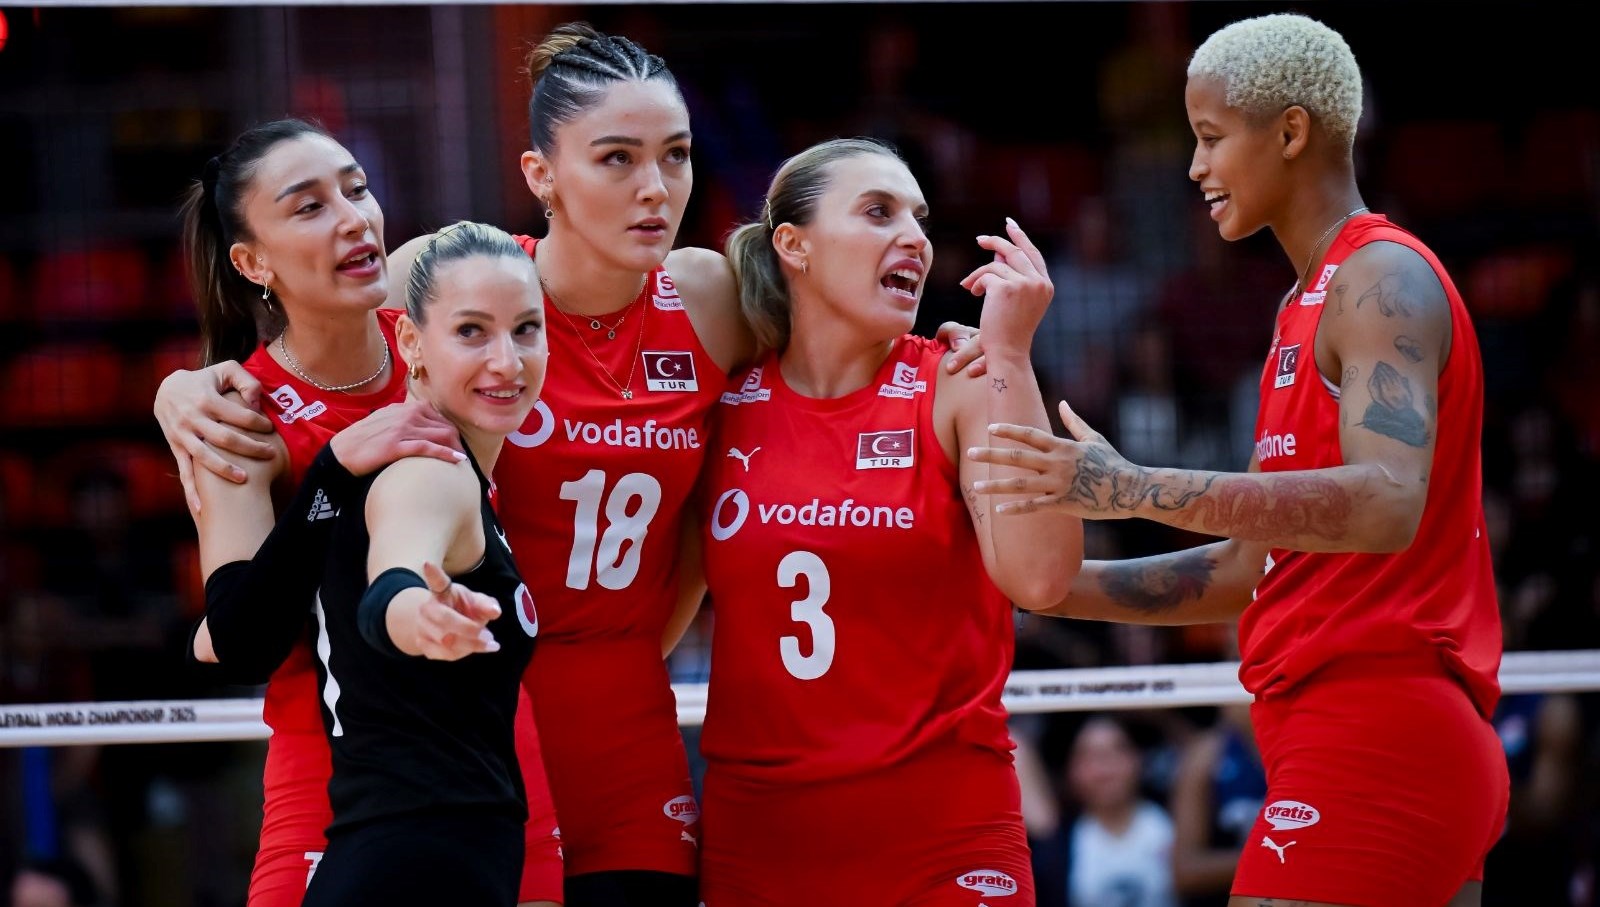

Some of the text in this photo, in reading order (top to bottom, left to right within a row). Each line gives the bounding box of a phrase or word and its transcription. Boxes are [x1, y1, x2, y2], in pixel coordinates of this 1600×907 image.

[899, 370, 914, 384] S
[659, 381, 687, 390] TUR
[276, 393, 293, 408] S
[563, 419, 700, 450] vodafone
[869, 457, 901, 467] TUR
[307, 488, 324, 522] adidas
[757, 498, 915, 529] vodafone
[559, 469, 662, 591] 18
[776, 550, 836, 680] 3
[45, 711, 85, 725] WORLD
[88, 708, 165, 725] CHAMPIONSHIP
[1267, 806, 1313, 820] gratis
[964, 875, 1013, 889] gratis
